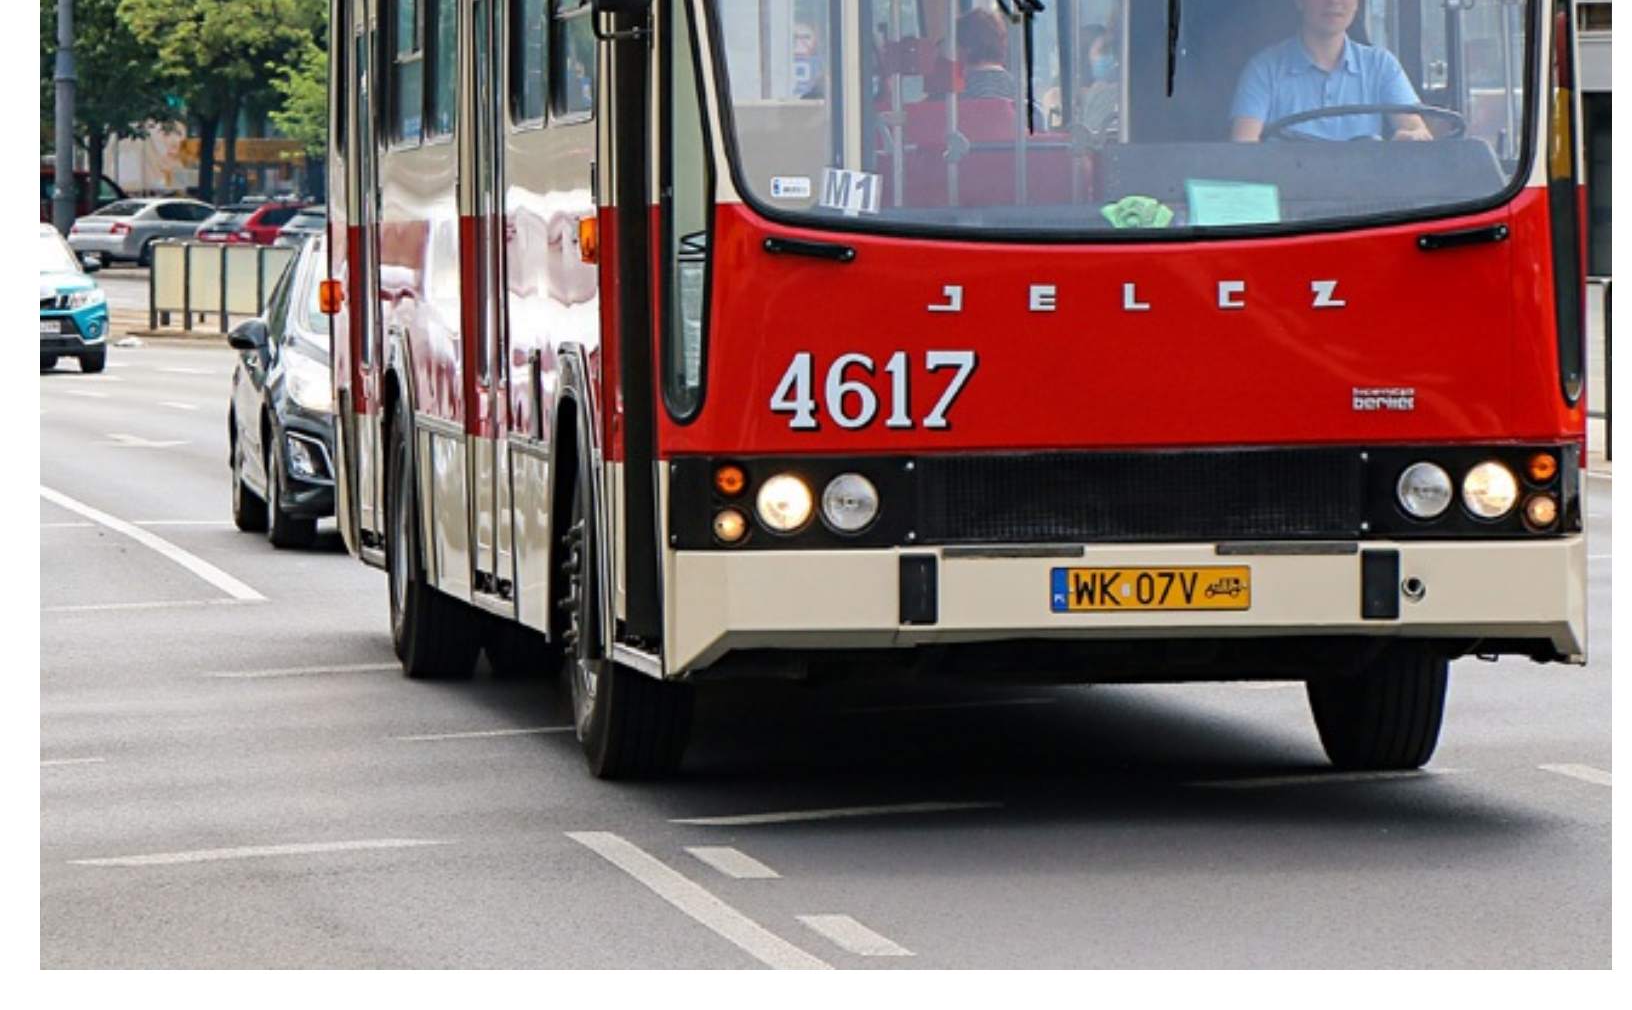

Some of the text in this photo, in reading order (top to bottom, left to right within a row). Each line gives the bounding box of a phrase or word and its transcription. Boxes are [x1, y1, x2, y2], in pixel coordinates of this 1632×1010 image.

[825, 171, 873, 210] M1
[928, 280, 1346, 311] JELCZ
[770, 350, 979, 429] 4617
[1074, 572, 1121, 605] WK
[1136, 572, 1199, 605] 07V
